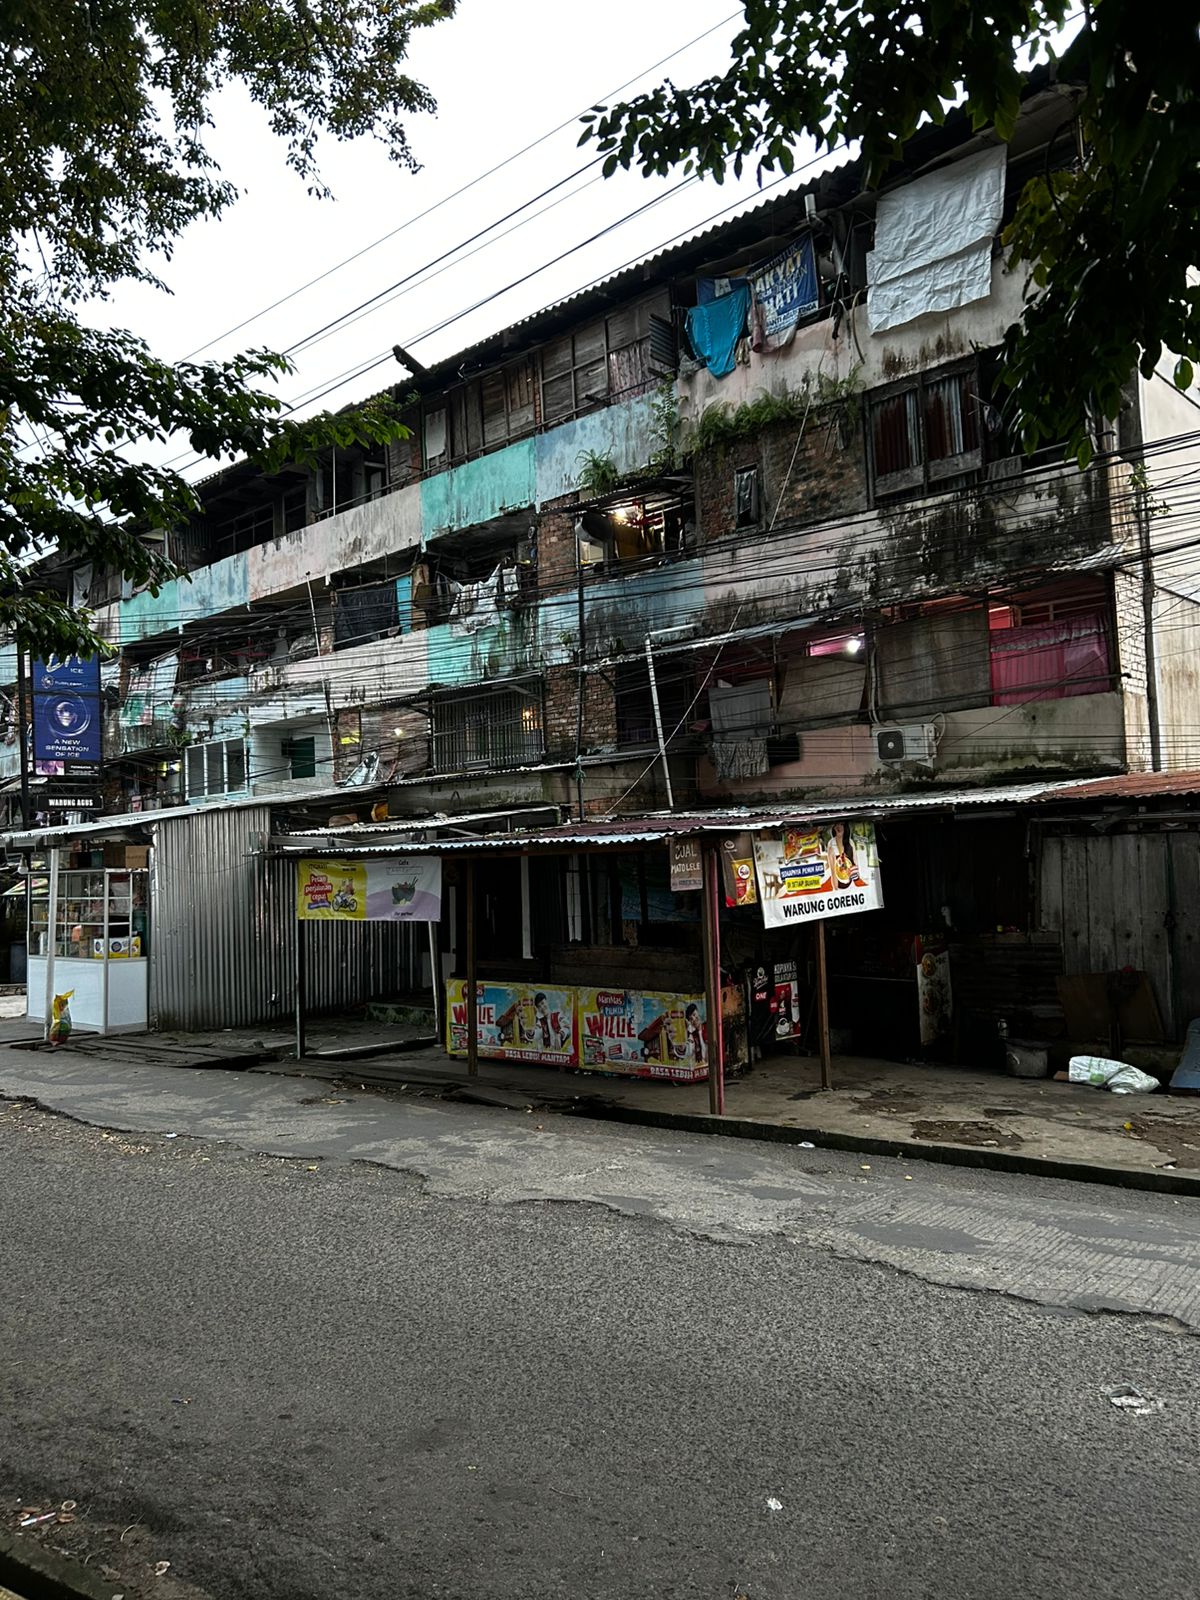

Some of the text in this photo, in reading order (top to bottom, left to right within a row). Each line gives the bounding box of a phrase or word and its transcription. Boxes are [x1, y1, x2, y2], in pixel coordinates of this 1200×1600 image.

[755, 249, 803, 293] AKYAT
[48, 798, 94, 807] WARUNG AGUS
[783, 893, 865, 918] WARUNG GORENG
[453, 1007, 495, 1025] WLIE
[586, 1015, 636, 1039] WILLIE
[650, 1067, 670, 1076] RASA
[671, 1068, 693, 1080] LEBIH
